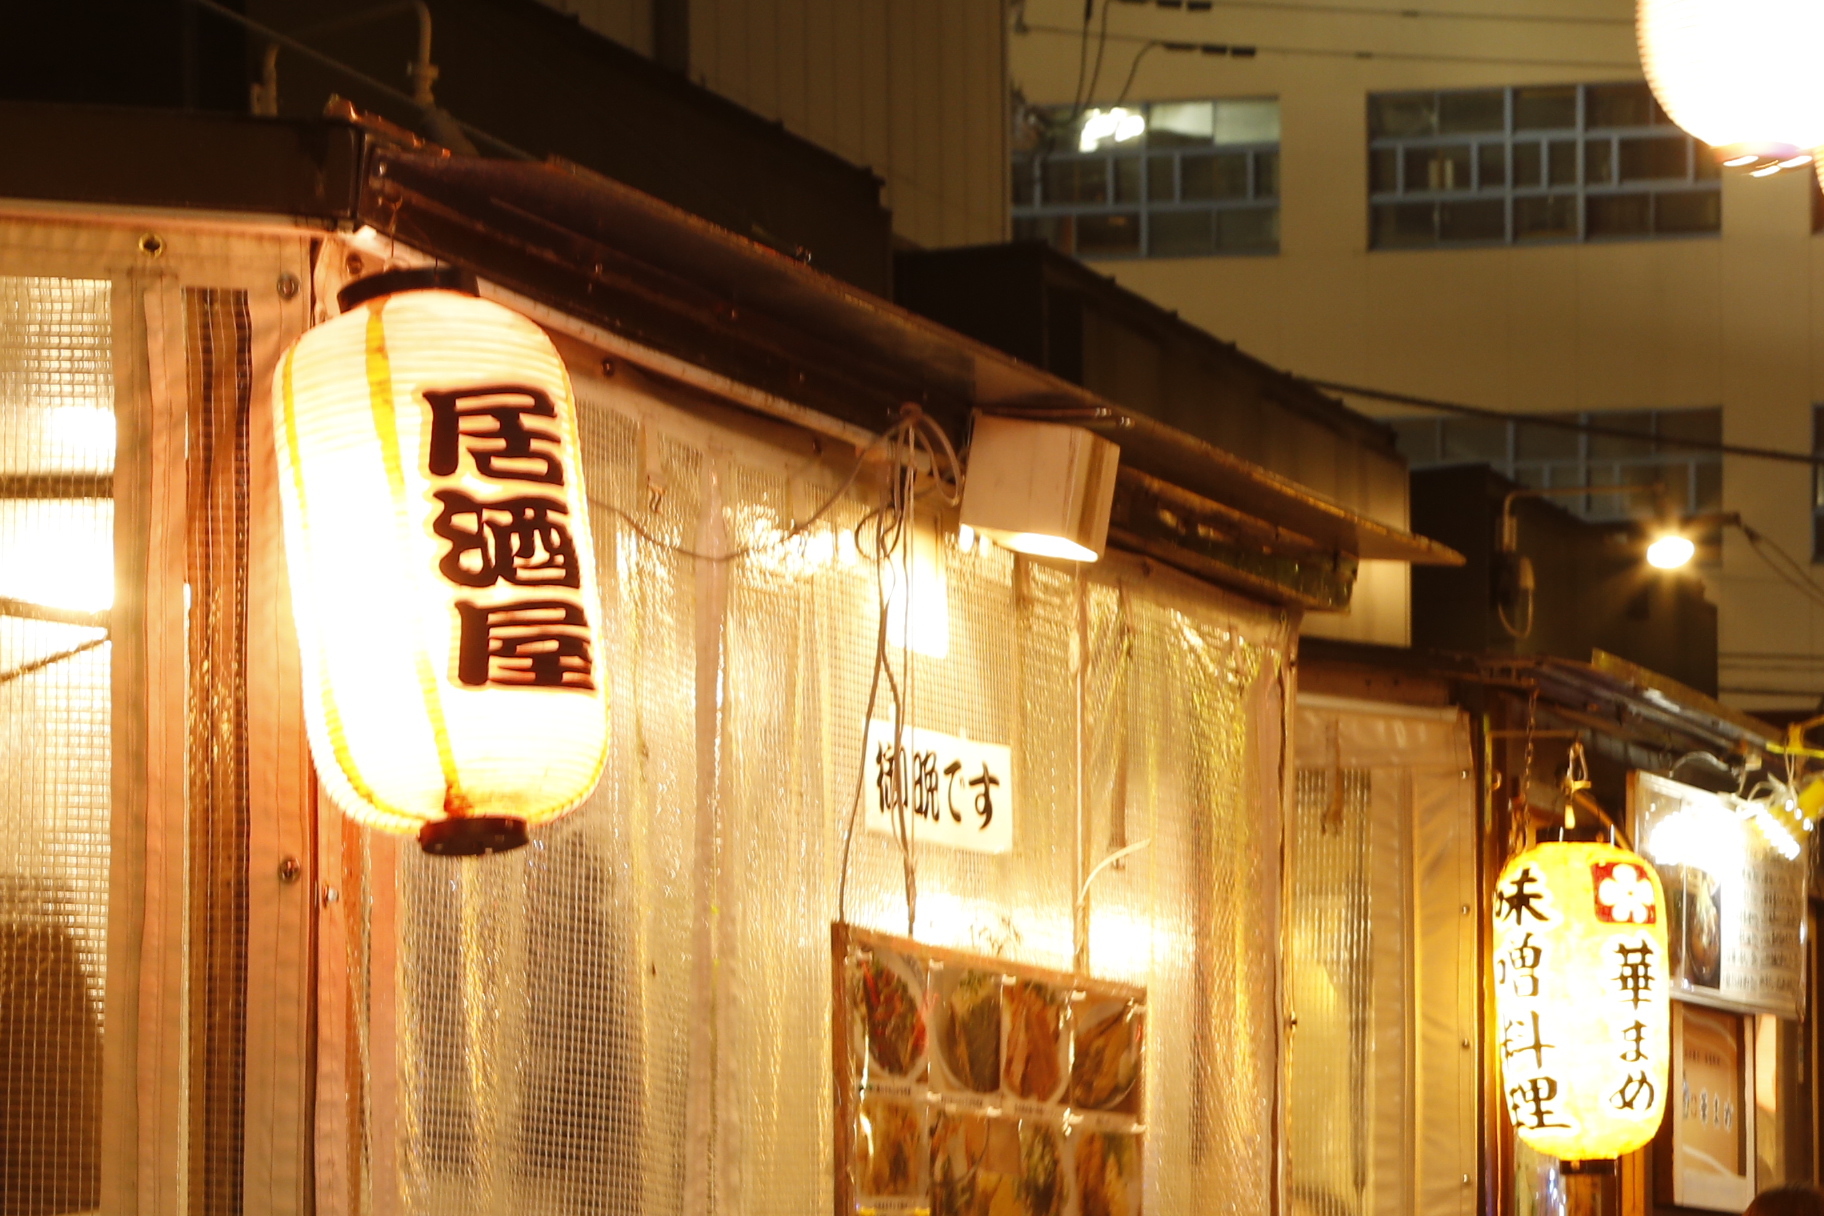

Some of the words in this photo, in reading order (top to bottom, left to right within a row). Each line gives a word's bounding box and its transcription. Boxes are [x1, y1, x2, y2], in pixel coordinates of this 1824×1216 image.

[423, 385, 595, 691] 居酒屋
[876, 741, 1000, 831] 御晩です
[1493, 868, 1572, 1130] 味噌料理
[1609, 939, 1656, 1112] 華まめ
